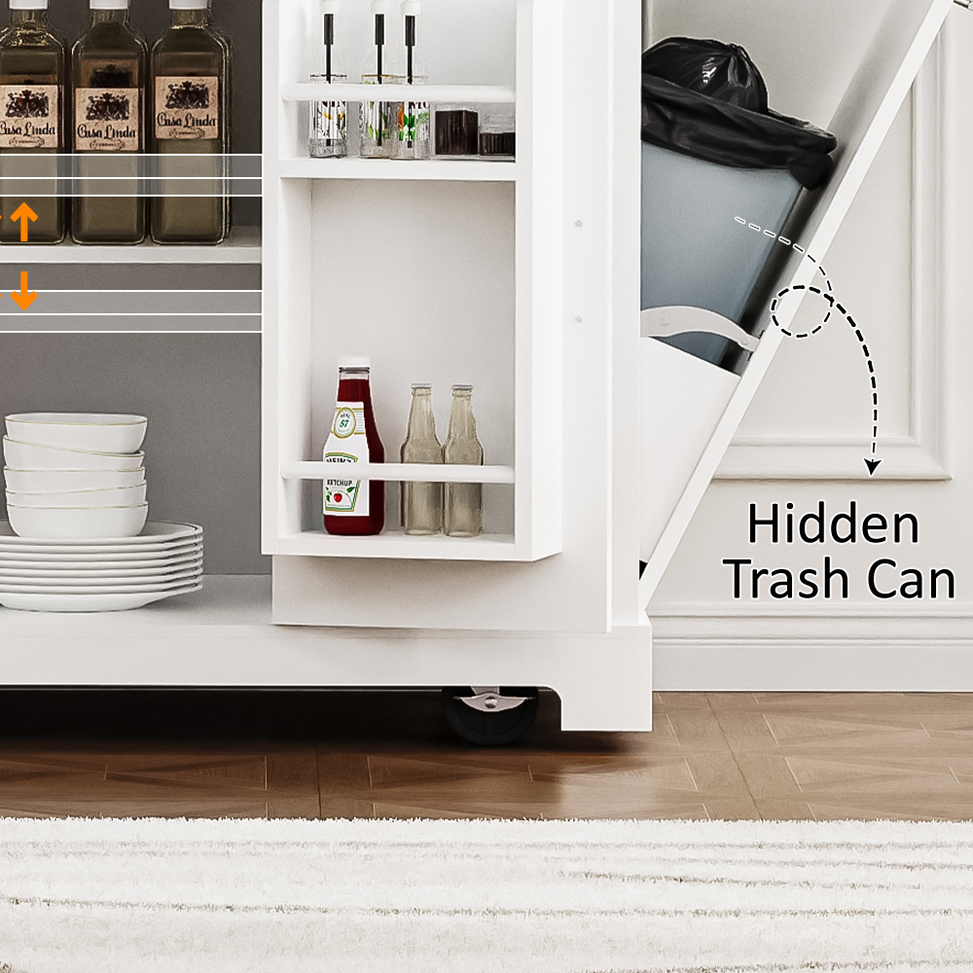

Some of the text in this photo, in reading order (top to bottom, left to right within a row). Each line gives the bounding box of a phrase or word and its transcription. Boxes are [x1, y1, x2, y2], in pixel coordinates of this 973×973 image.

[157, 112, 217, 128] Casa Linda
[23, 121, 56, 137] Linda
[77, 123, 136, 140] Casa Linda
[339, 419, 350, 428] 57
[327, 479, 353, 487] KETCHUP
